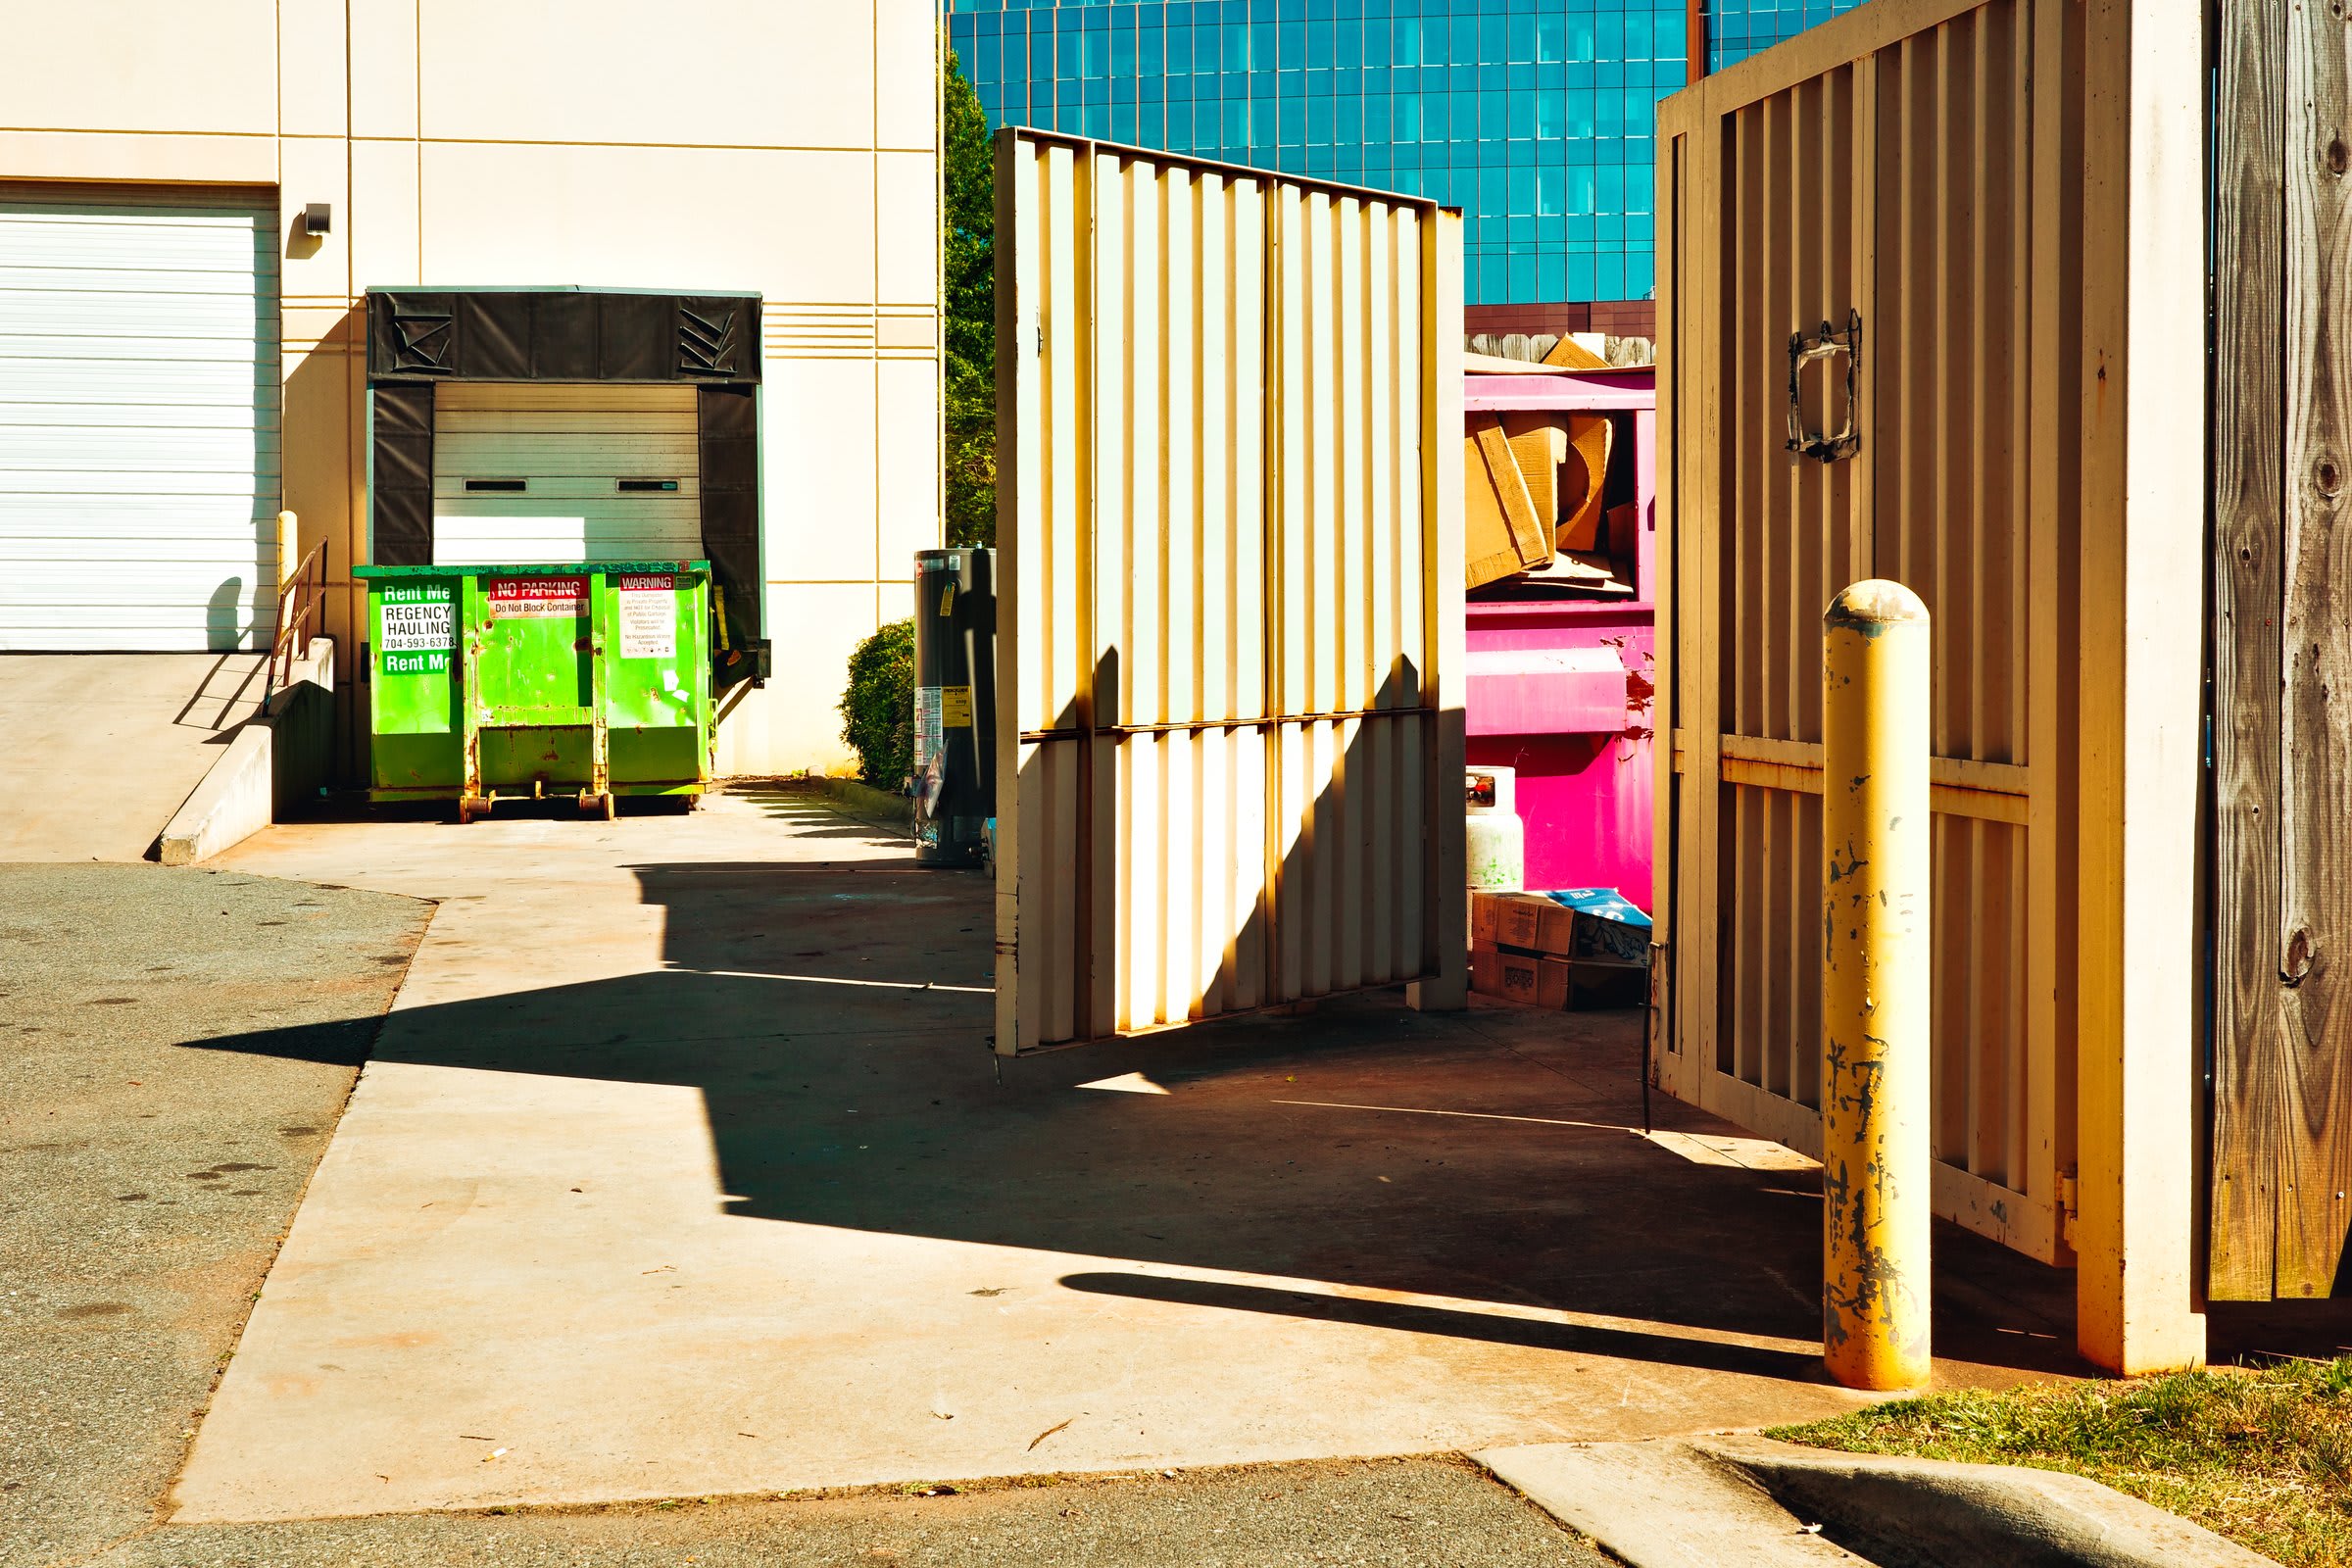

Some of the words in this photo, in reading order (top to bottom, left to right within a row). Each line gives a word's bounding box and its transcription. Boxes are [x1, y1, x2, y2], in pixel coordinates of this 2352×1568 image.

[497, 582, 517, 598] NO
[521, 581, 580, 597] PARKING
[622, 577, 672, 589] WARNING
[384, 584, 422, 602] Rent
[427, 583, 451, 600] Me
[386, 606, 451, 620] REGENCY
[495, 604, 507, 613] Do
[508, 603, 522, 612] Not
[523, 602, 546, 612] Block
[547, 602, 584, 612] Container
[387, 621, 451, 635] HAULING
[384, 636, 455, 649] 704-593-6378
[386, 655, 424, 671] Rent
